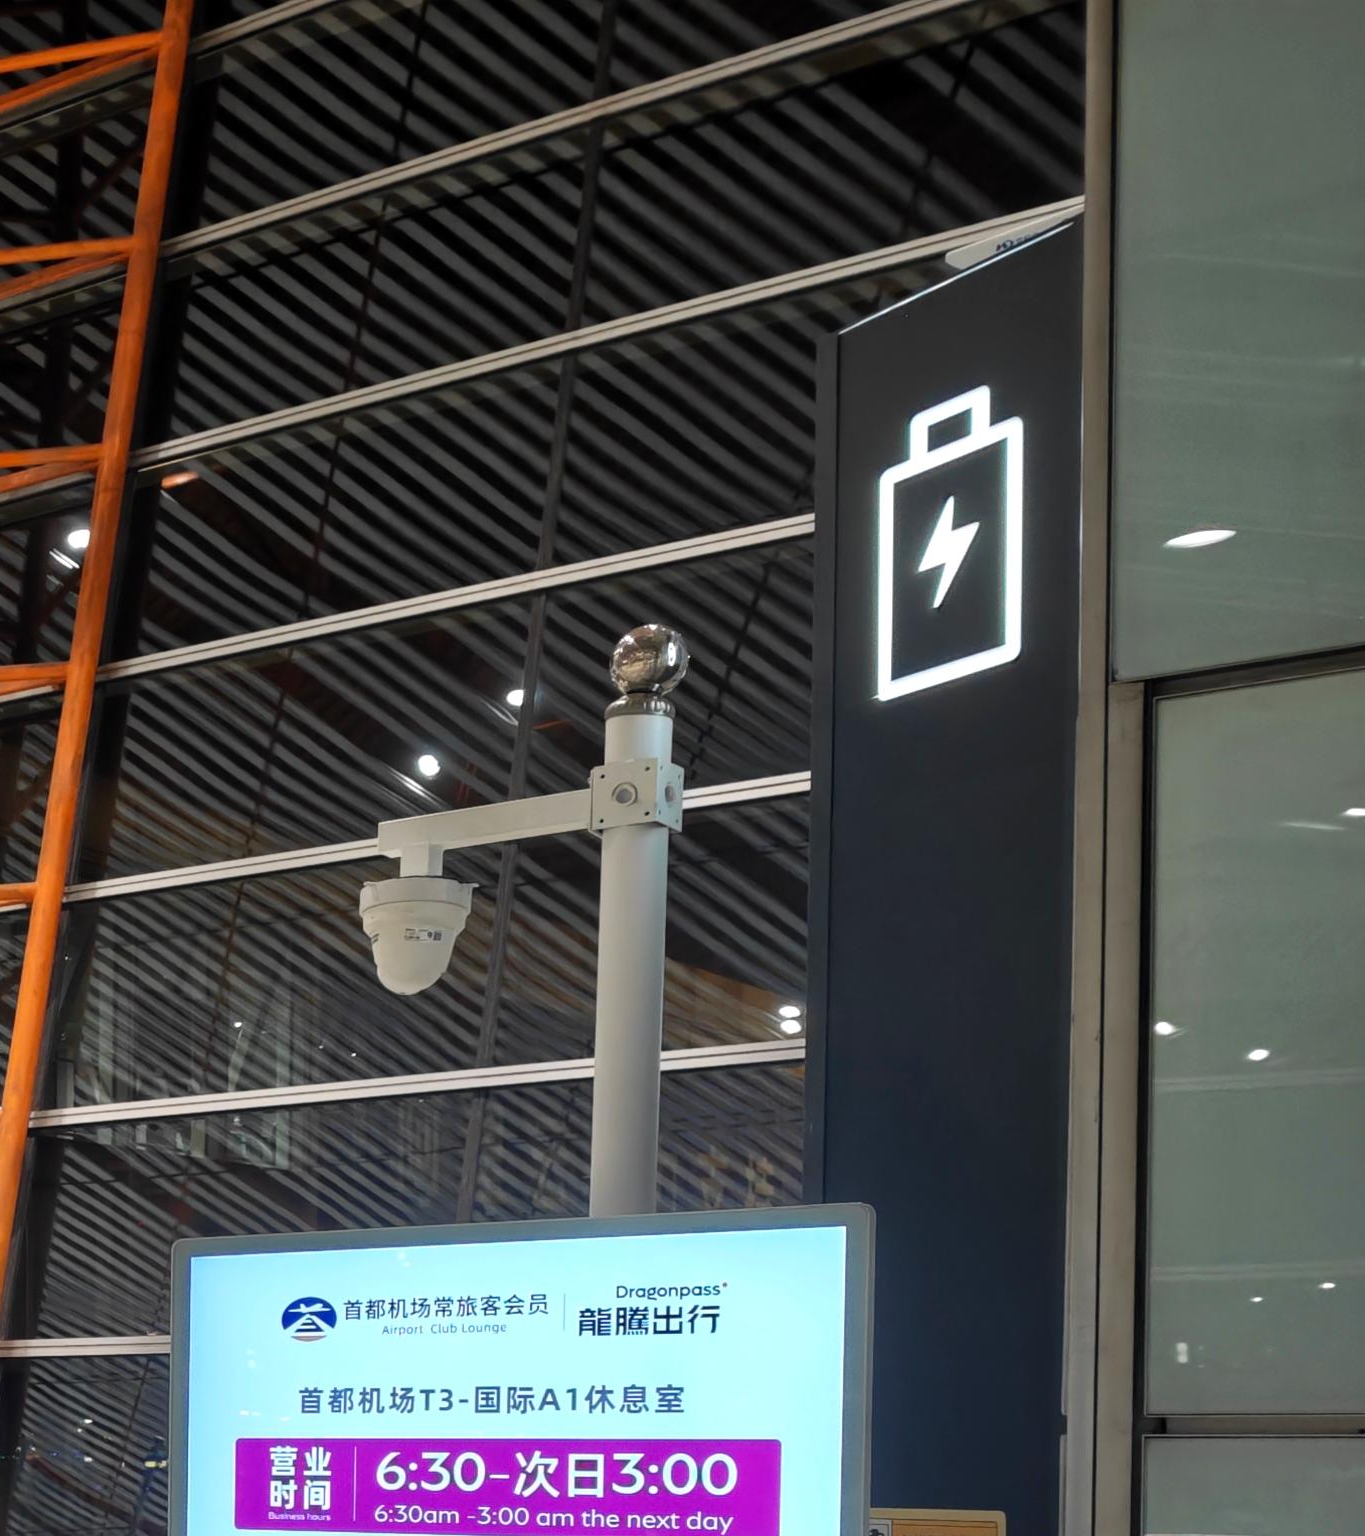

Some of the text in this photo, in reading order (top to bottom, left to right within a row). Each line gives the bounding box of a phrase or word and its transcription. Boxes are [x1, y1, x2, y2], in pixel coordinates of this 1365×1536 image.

[343, 1293, 549, 1322] 首都机场常旅客会员
[616, 1284, 722, 1301] Dragonpass
[382, 1322, 508, 1336] Airport Club Lounge
[578, 1305, 722, 1337] 龍騰出行
[299, 1384, 686, 1416] 首都机场T3-国际A1休息室
[269, 1446, 332, 1478] 营业
[269, 1479, 332, 1511] 时间
[269, 1511, 332, 1522] Business hours
[374, 1504, 734, 1535] 6:30am -3:00 am the next day
